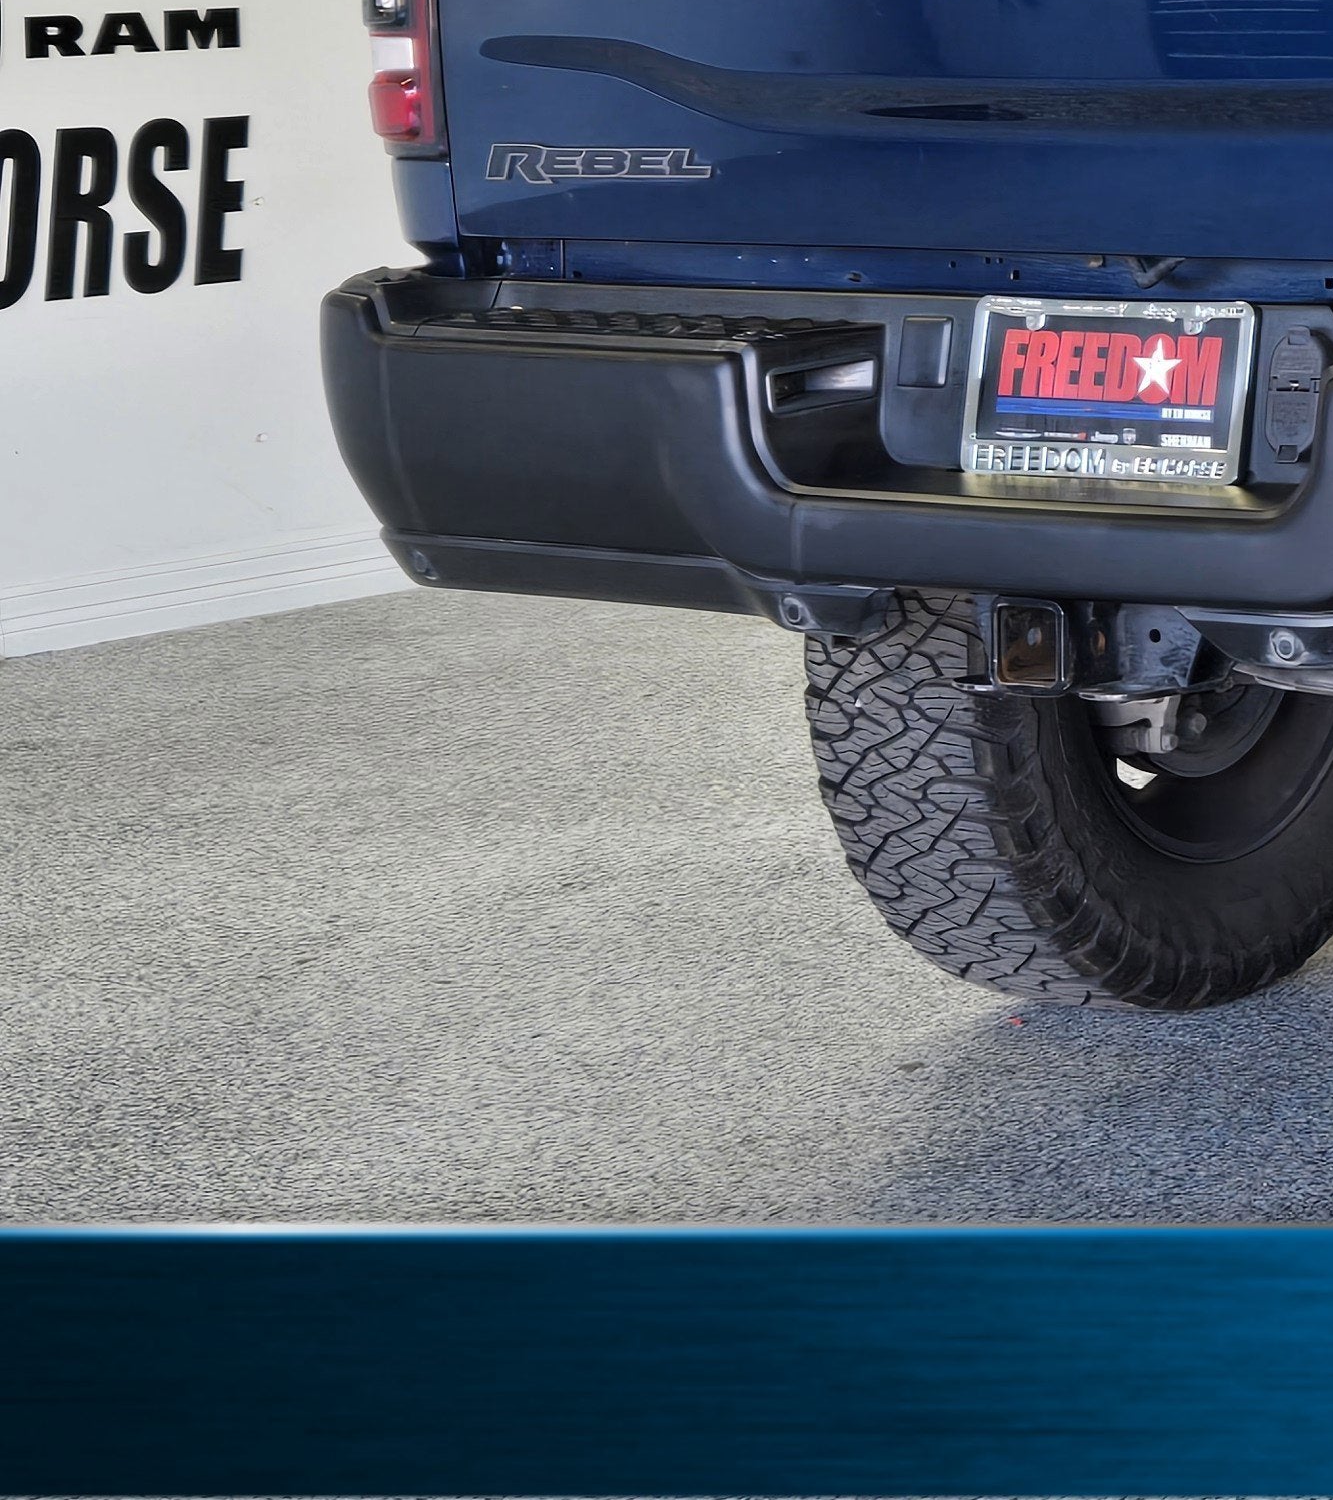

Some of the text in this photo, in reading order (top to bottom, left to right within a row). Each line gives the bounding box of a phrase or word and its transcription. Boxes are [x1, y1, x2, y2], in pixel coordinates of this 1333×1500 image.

[24, 7, 241, 60] RAM
[485, 143, 712, 184] REBEL
[0, 115, 250, 311] ORSE
[997, 328, 1223, 406] FREEDOM
[972, 444, 1107, 474] FREEDOM
